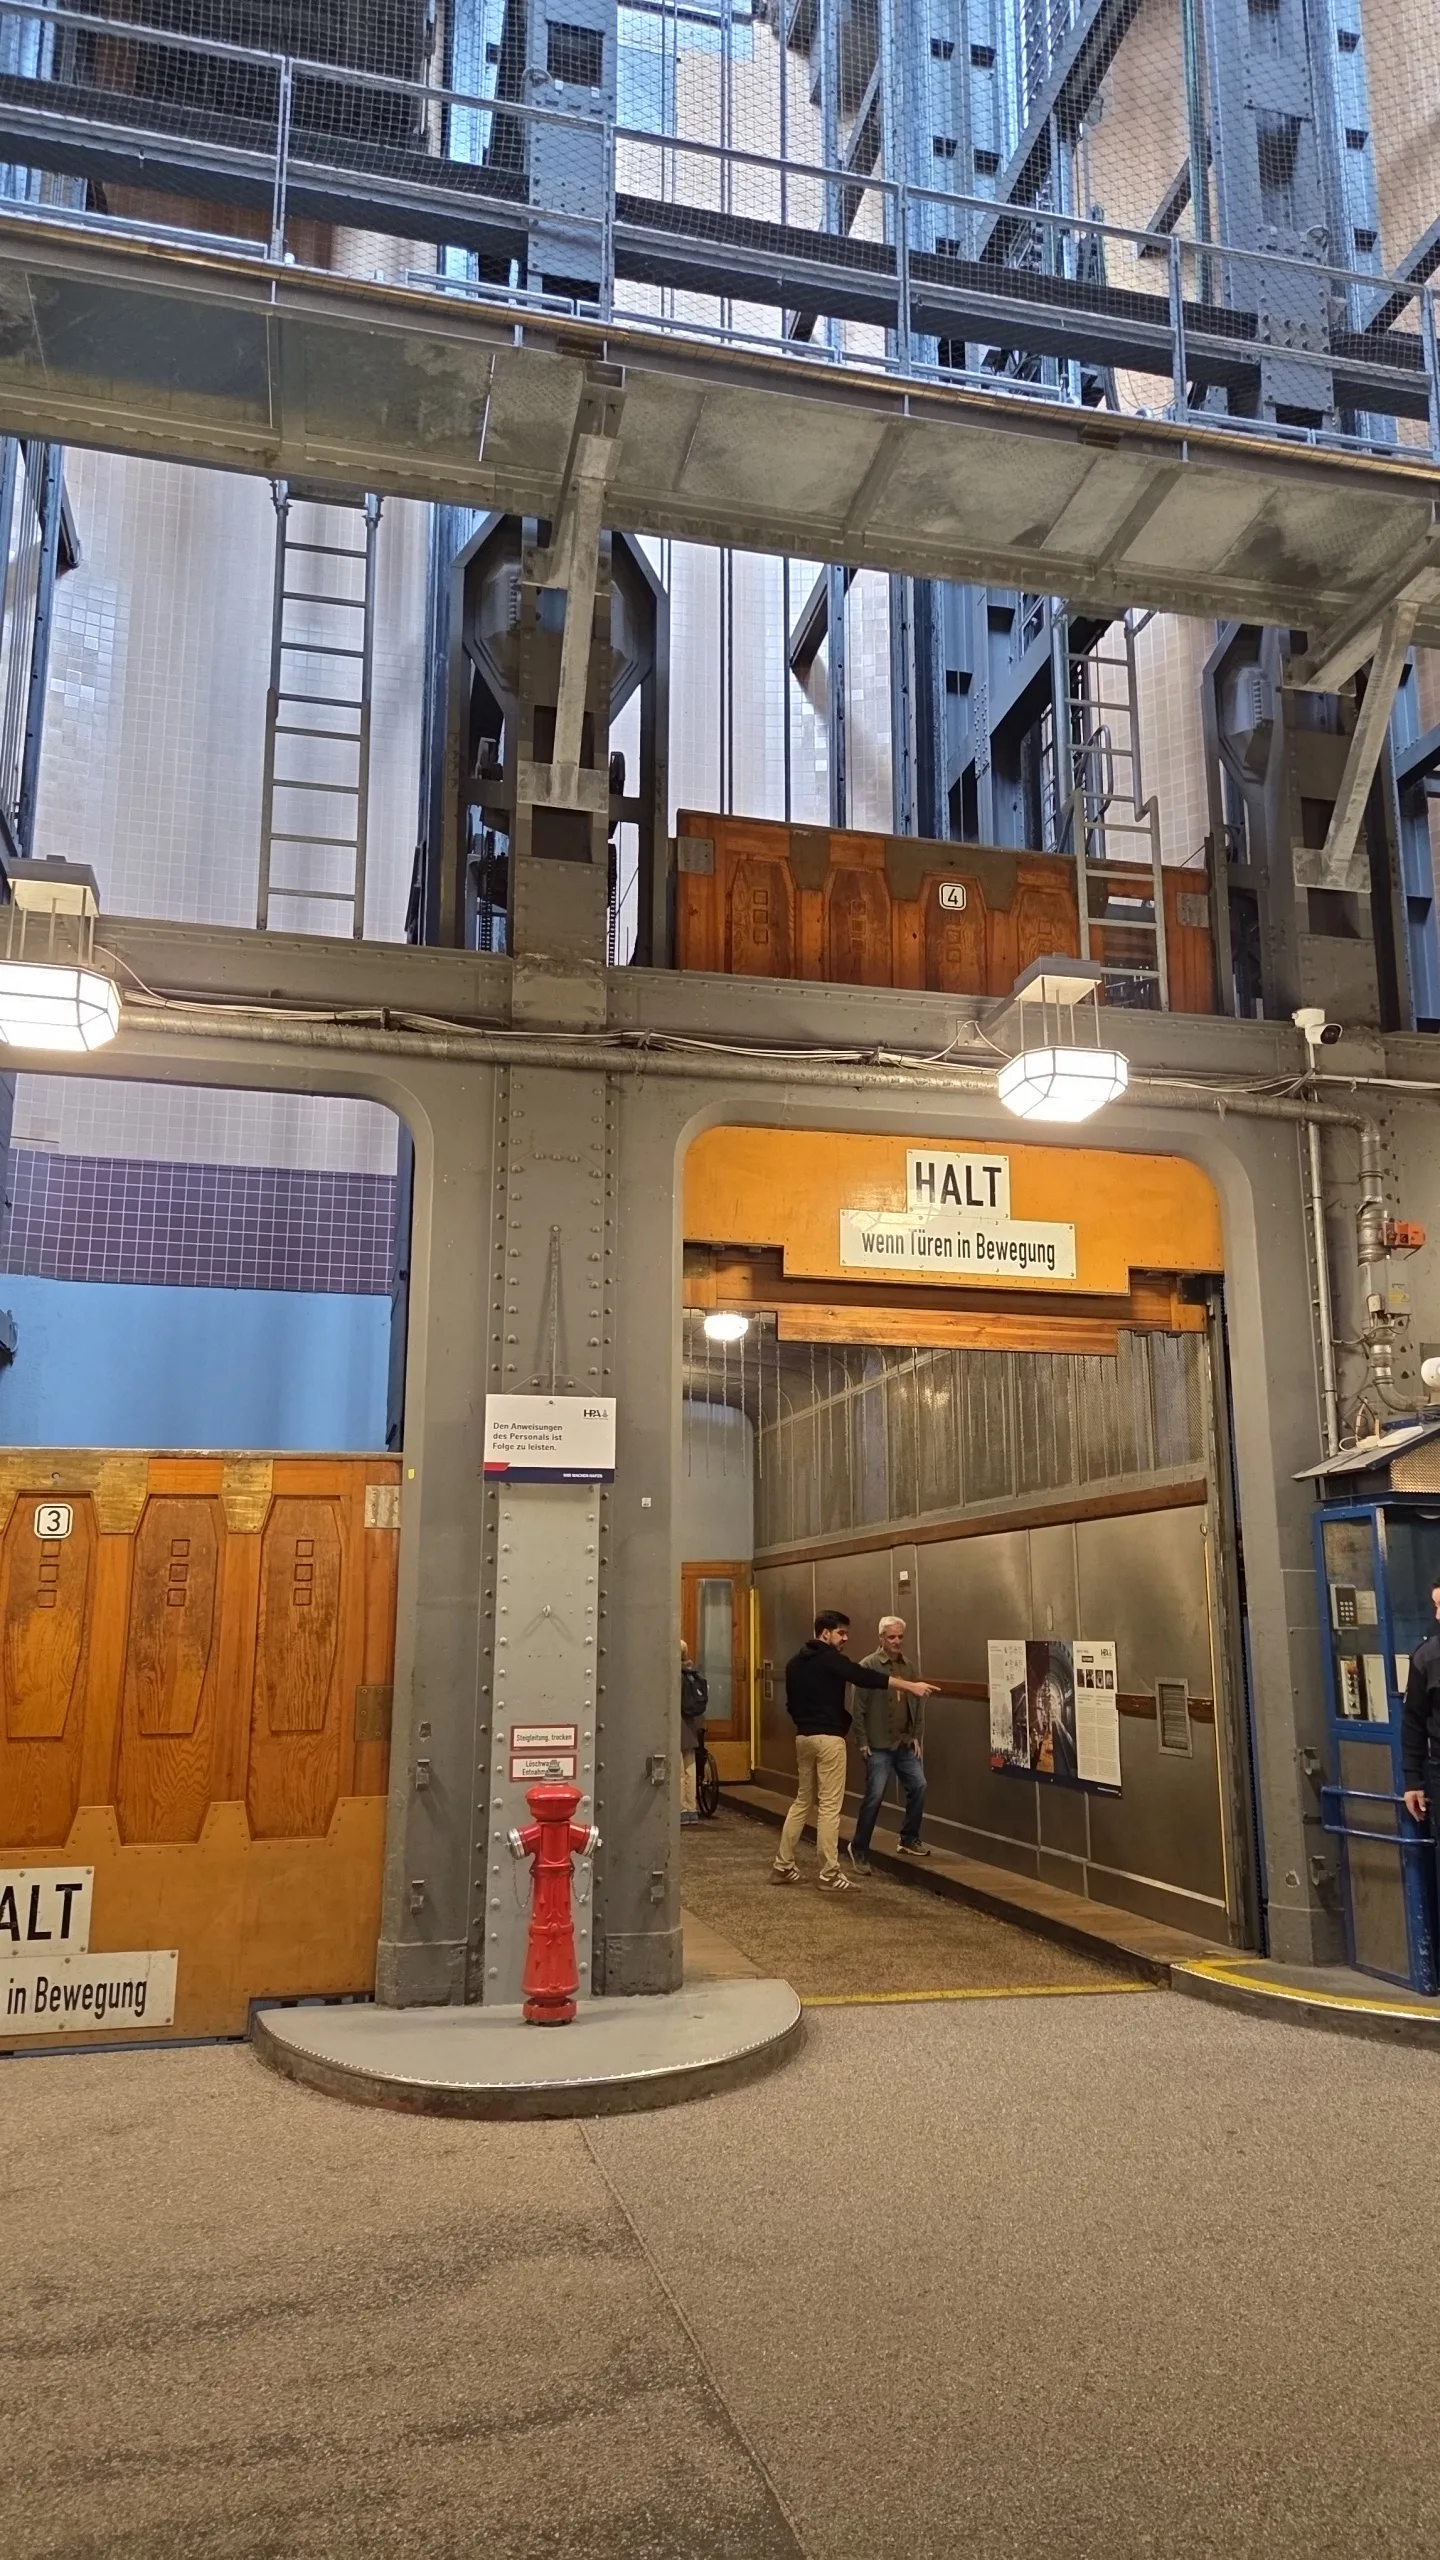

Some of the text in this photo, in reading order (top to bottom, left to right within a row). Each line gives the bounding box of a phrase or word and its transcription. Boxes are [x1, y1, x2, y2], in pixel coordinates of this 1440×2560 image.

[947, 888, 959, 905] 4
[915, 1161, 1002, 1208] HALT
[861, 1228, 1055, 1271] wenn Türen in Bewegung
[583, 1409, 601, 1417] HPA
[493, 1422, 563, 1432] Den Anweisungen
[510, 1433, 549, 1441] Personals
[552, 1433, 562, 1441] ist
[492, 1442, 515, 1451] Folge
[528, 1443, 557, 1451] leisten.
[46, 1510, 61, 1532] 3
[551, 1733, 573, 1741] trocken
[0, 1883, 83, 1942] ALT
[7, 1976, 148, 2020] in Bewegung
